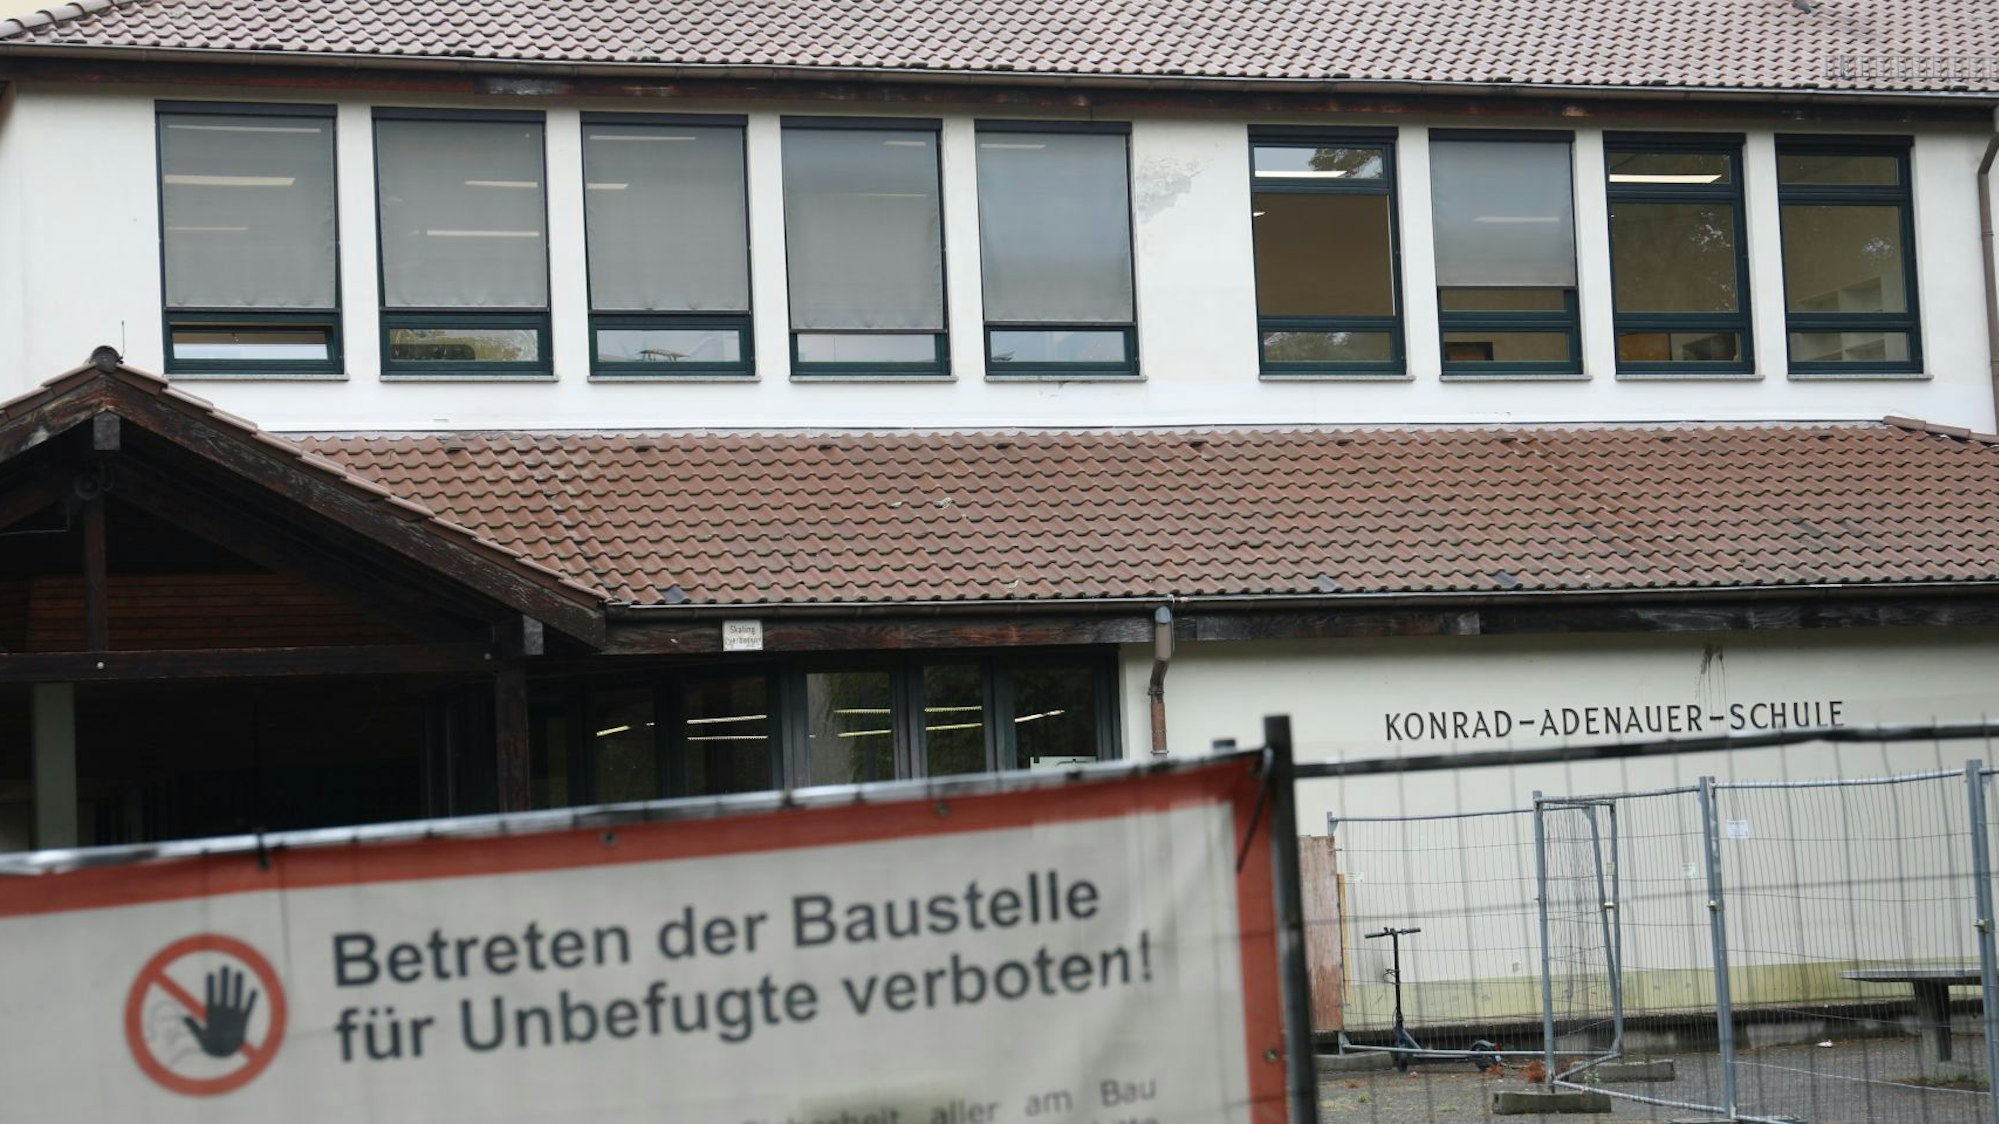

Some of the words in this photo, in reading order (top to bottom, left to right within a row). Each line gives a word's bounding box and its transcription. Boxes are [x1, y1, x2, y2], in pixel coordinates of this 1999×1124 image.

[1385, 701, 1845, 741] KONRAD-ADENAUER-SCHULE
[333, 922, 630, 987] Betreten
[658, 907, 768, 960] der
[793, 870, 1099, 948] Baustelle
[335, 1010, 434, 1062] für
[461, 975, 819, 1053] Unbefugte
[842, 930, 1152, 1016] verboten!
[1025, 1088, 1073, 1117] am
[1098, 1077, 1158, 1107] Bau
